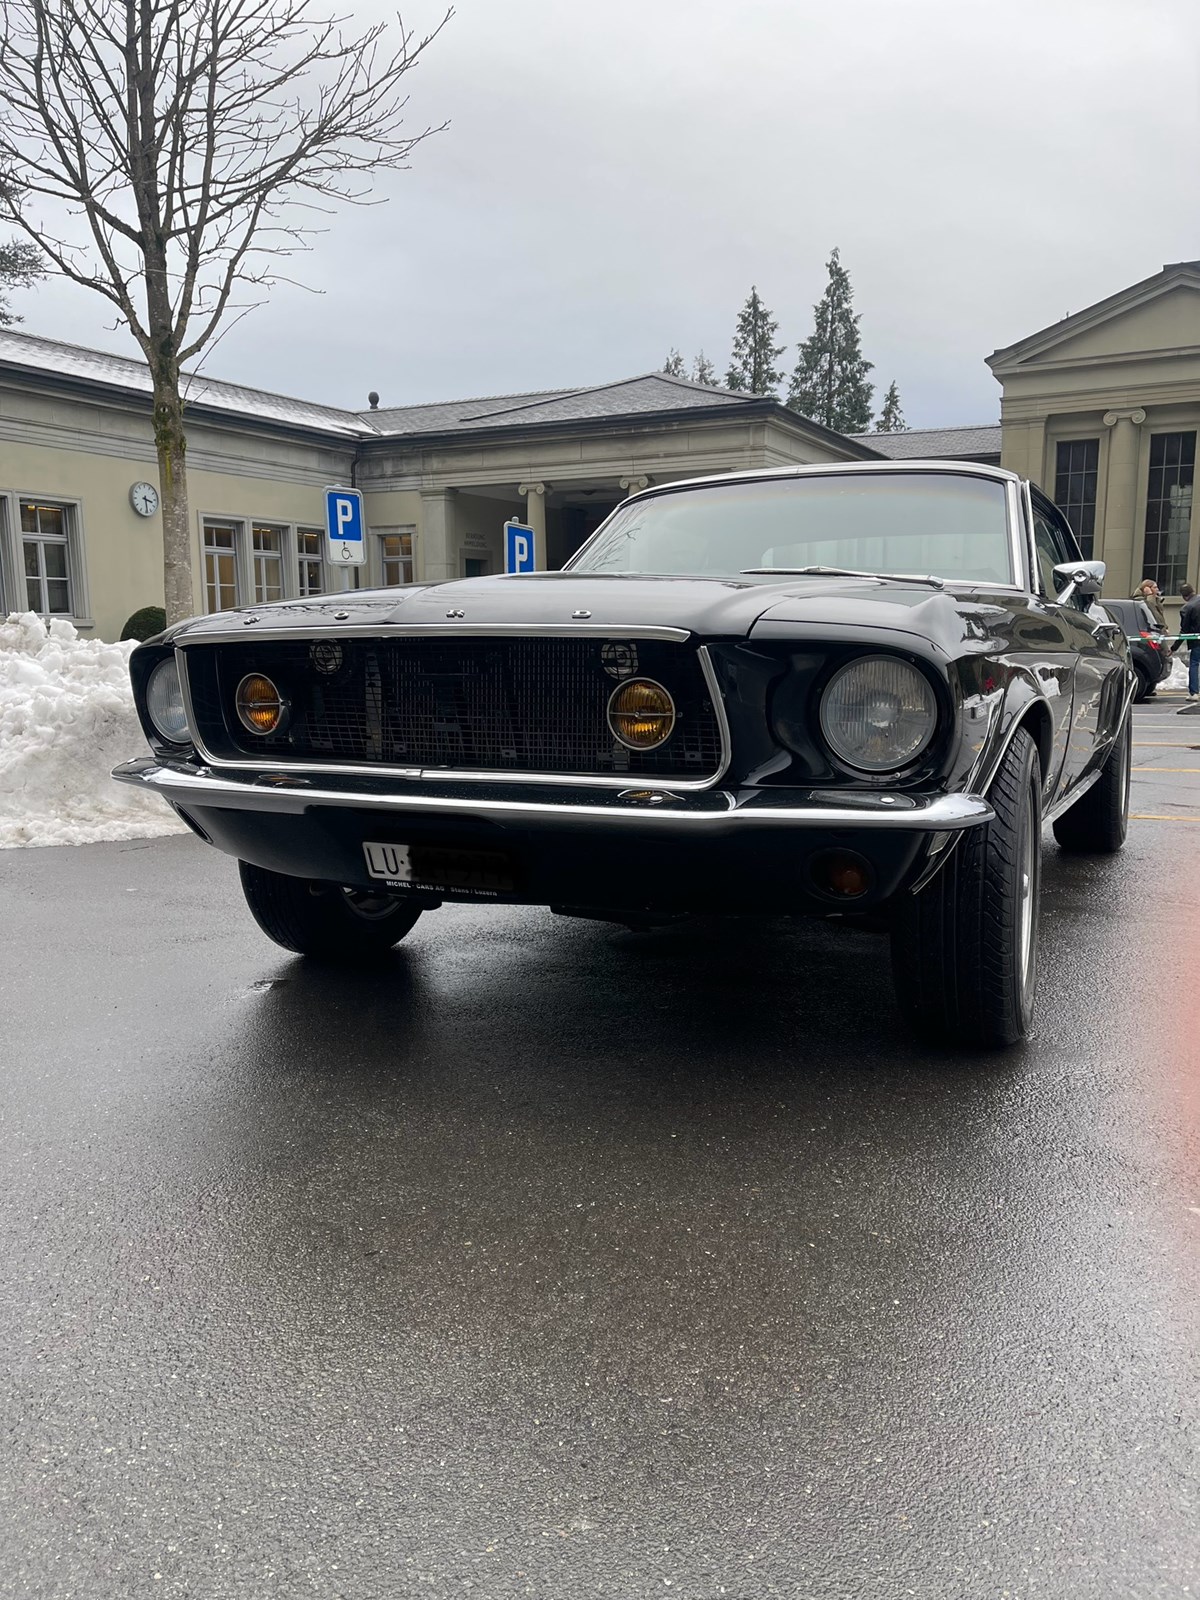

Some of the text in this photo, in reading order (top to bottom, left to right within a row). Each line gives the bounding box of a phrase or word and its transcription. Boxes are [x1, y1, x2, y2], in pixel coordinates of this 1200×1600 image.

[336, 499, 353, 535] P
[515, 535, 528, 573] P
[386, 880, 411, 889] MICHEL
[416, 883, 434, 891] CARS
